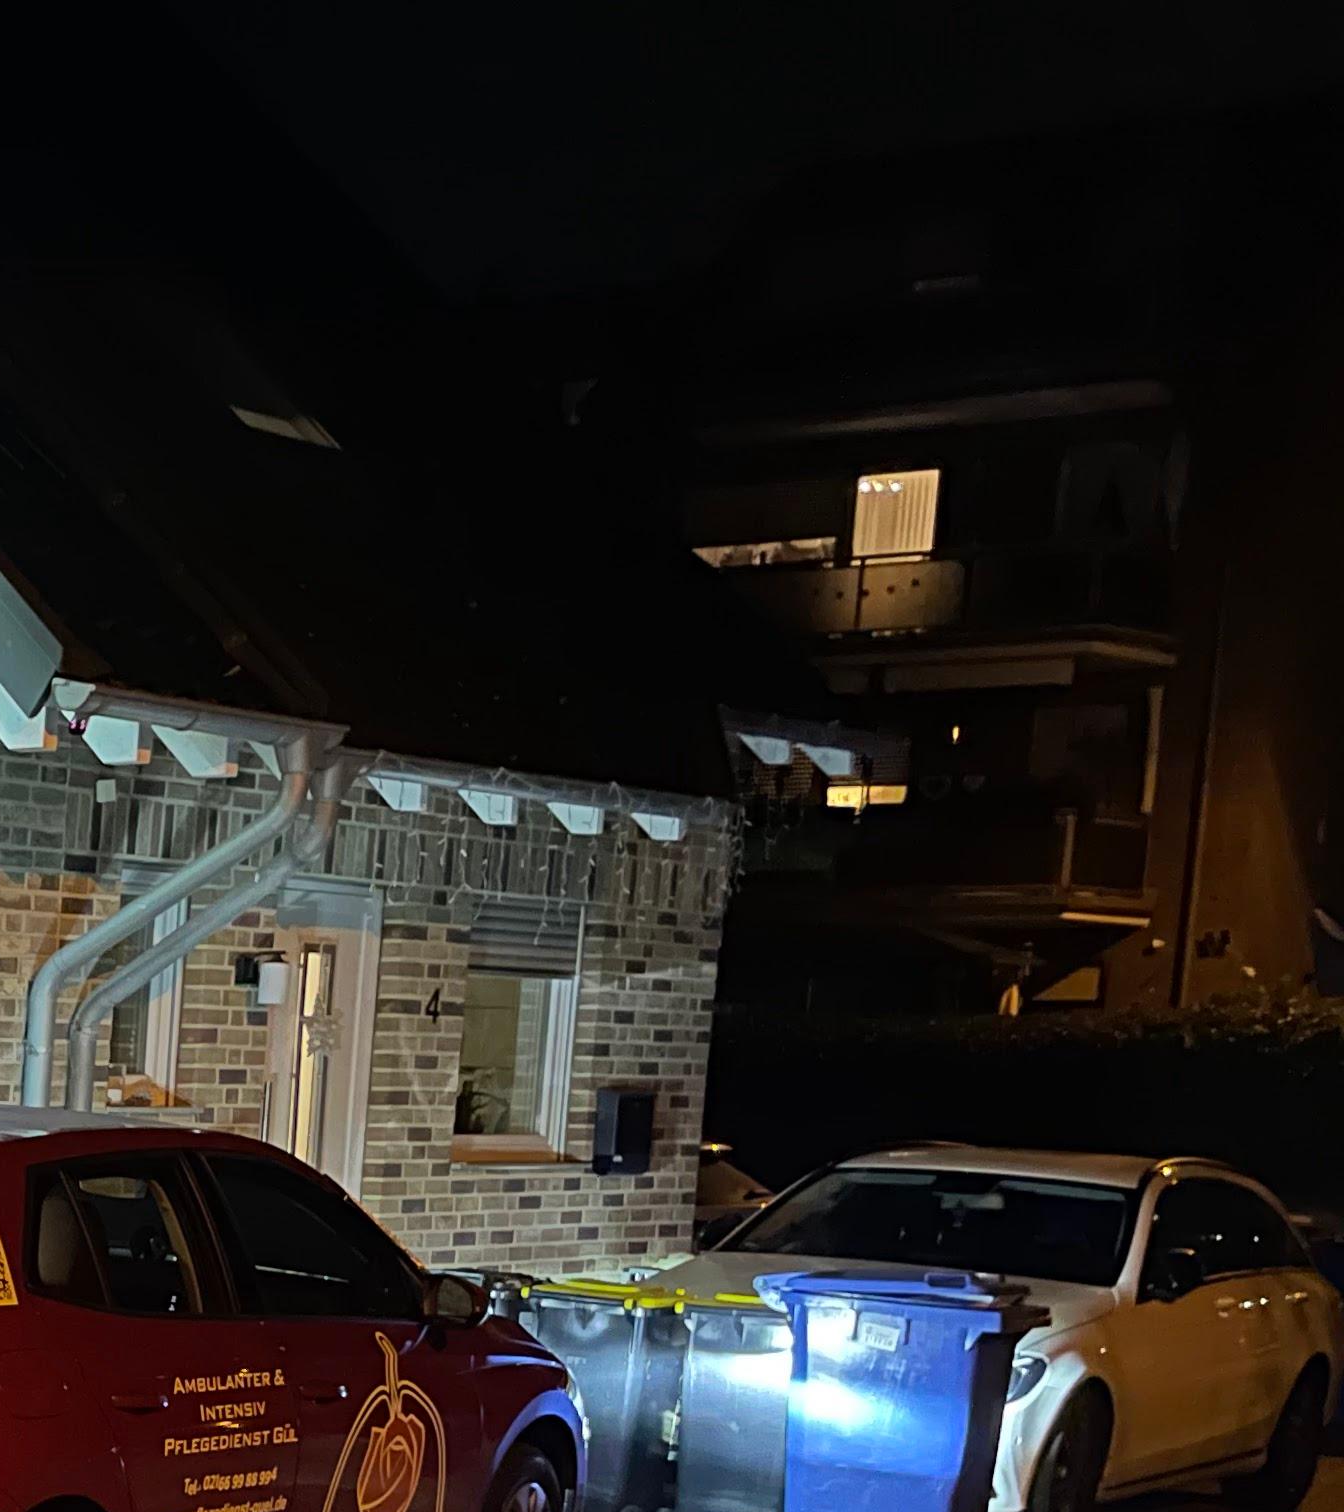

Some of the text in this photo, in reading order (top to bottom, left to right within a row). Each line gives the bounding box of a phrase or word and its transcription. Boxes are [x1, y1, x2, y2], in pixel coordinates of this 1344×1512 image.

[425, 988, 440, 1024] 4
[174, 1369, 285, 1395] AMBULANTER &
[200, 1401, 266, 1422] INTENSIV
[164, 1423, 299, 1457] PFLEGEDIENST GÜL
[184, 1477, 202, 1495] Tel.
[203, 1473, 231, 1491] 02166
[232, 1473, 244, 1489] 99
[258, 1466, 278, 1486] 994
